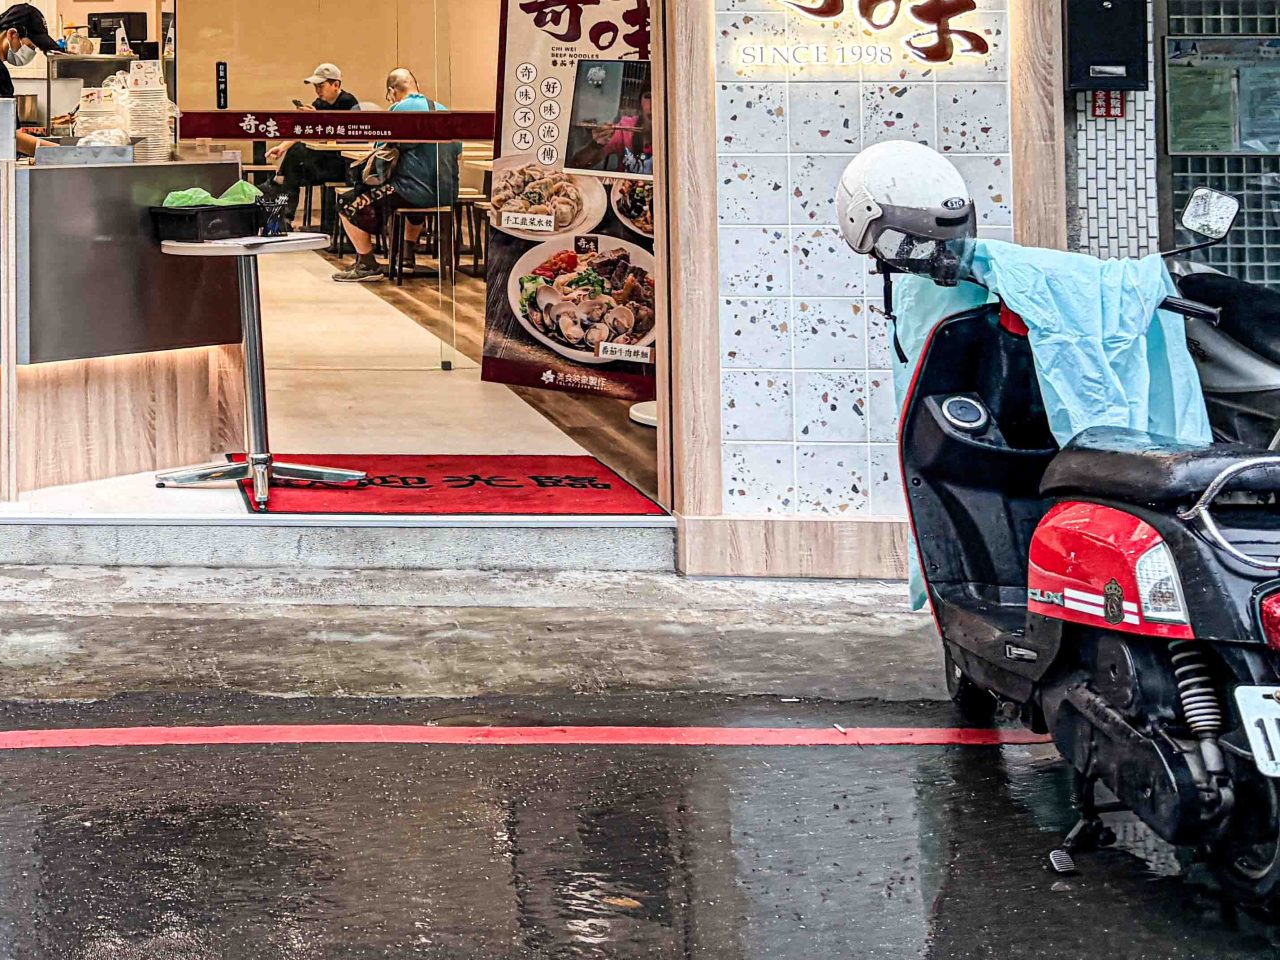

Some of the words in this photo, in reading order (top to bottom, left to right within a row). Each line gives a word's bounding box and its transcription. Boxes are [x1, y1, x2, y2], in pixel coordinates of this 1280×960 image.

[742, 45, 829, 65] SINCE
[835, 45, 893, 65] 1998
[516, 66, 534, 145] 奇味不凡
[239, 113, 280, 138] 奇味
[293, 124, 346, 135] 番茄牛肉麵
[541, 81, 558, 162] 好味流傳
[270, 473, 613, 490] 迎光臨
